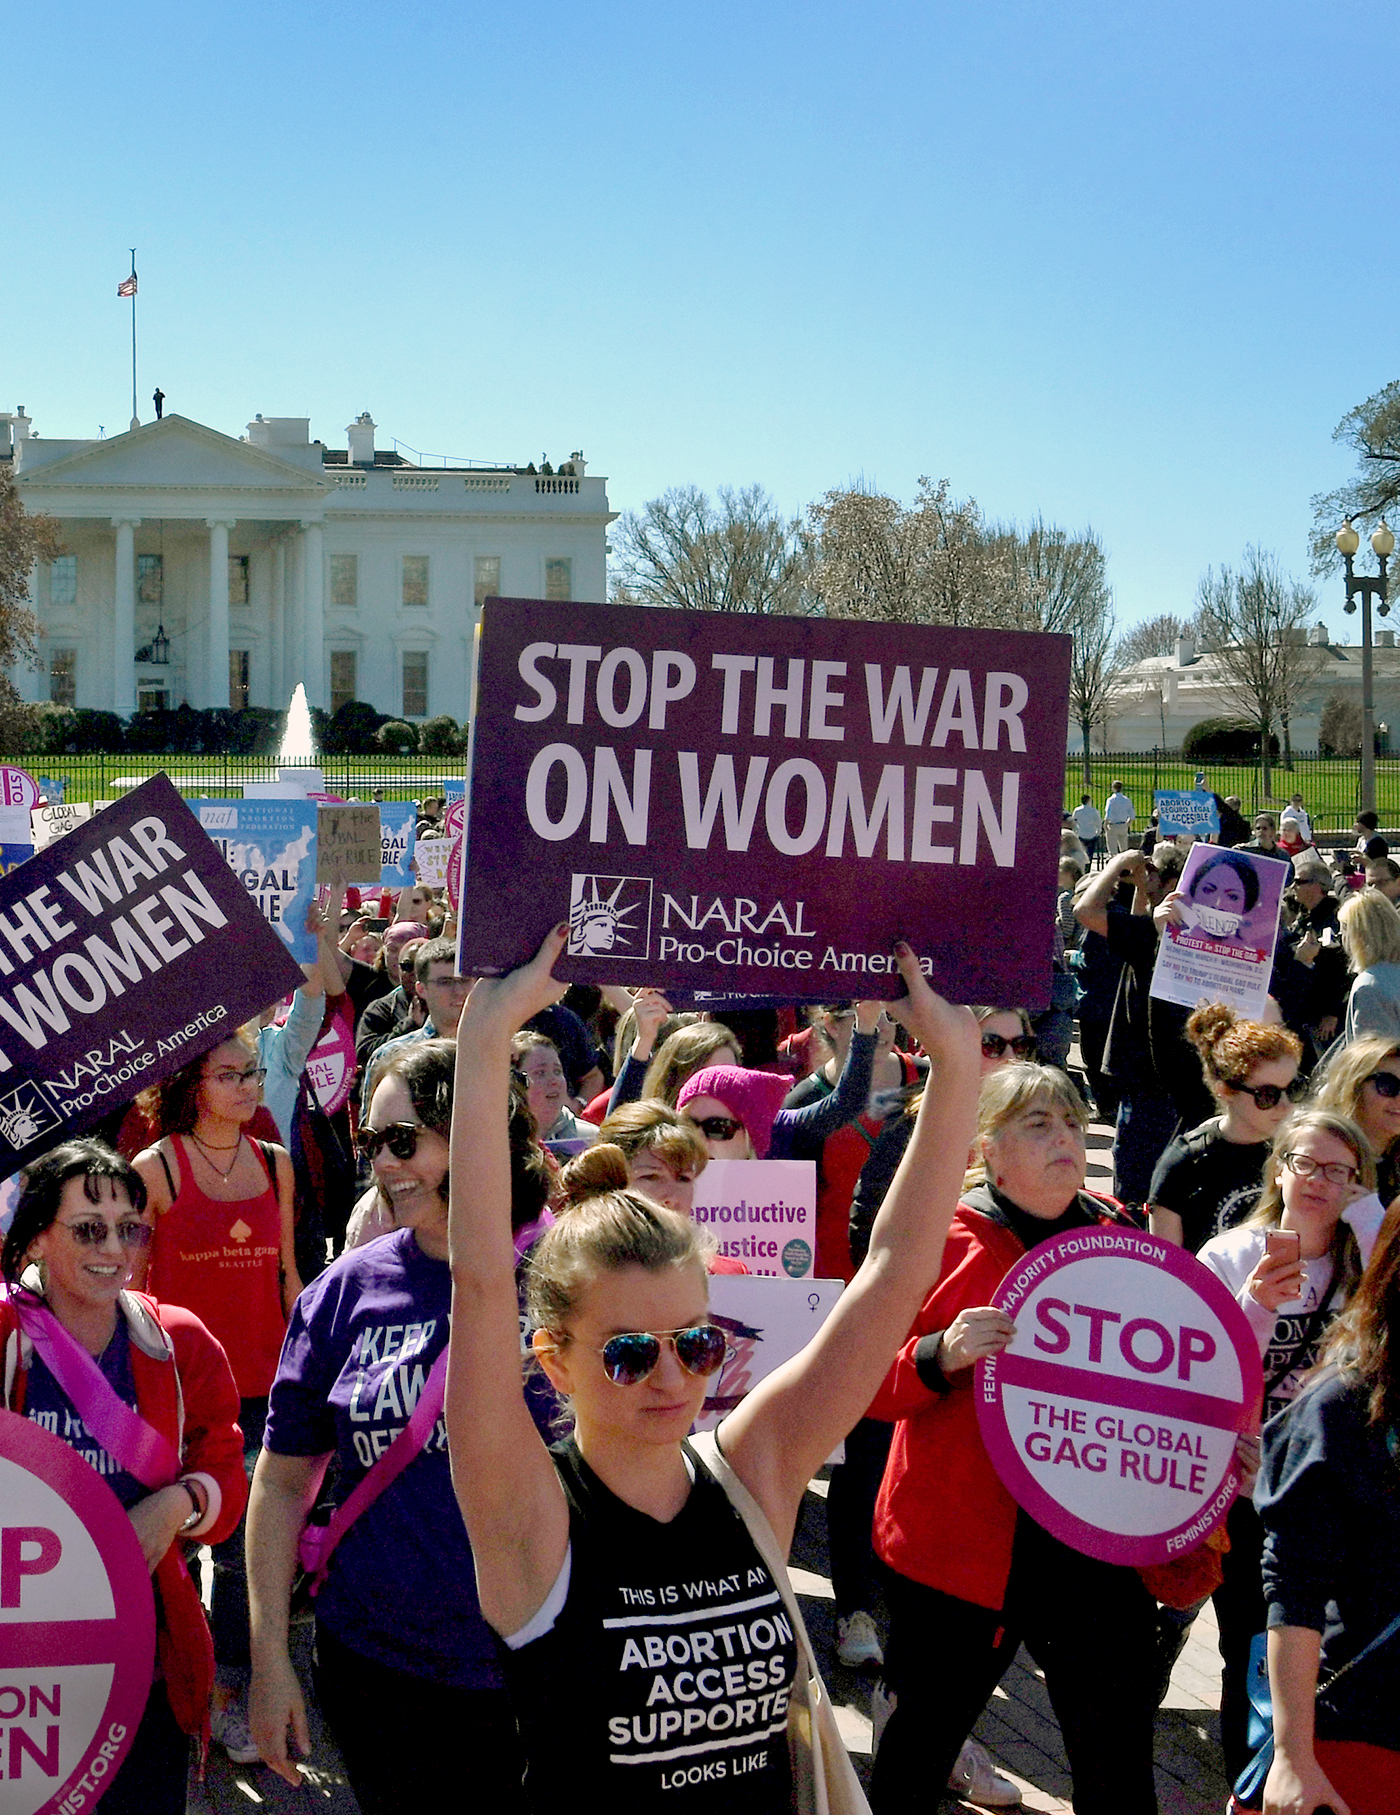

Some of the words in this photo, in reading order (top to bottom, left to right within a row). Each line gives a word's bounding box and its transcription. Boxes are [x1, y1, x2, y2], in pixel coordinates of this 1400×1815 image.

[513, 642, 697, 730] STOP
[712, 653, 848, 741] THE
[864, 662, 1029, 752] WAR
[11, 775, 23, 805] STO
[525, 742, 652, 846] ON
[678, 751, 1020, 868] WOMEN
[42, 806, 81, 822] GLOBAL
[49, 820, 73, 835] GAG
[204, 808, 234, 829] naf
[349, 810, 374, 824] the
[57, 816, 186, 918] WAR
[661, 893, 816, 937] NARAL
[659, 937, 813, 971] Pro-Choice
[819, 946, 933, 976] Amera
[1214, 944, 1230, 956] STOP
[1231, 948, 1244, 959] THE
[44, 1029, 144, 1100] NARAL
[60, 1052, 156, 1119] Pro-Choice
[157, 1003, 228, 1055] America
[180, 1250, 220, 1262] kappa
[223, 1246, 251, 1257] beta
[219, 1259, 263, 1269] SEATTLE
[1000, 1250, 1055, 1315] MAJORITY
[1058, 1235, 1167, 1262] FOUNDATION
[359, 1319, 437, 1365] KEEP
[1033, 1297, 1217, 1382] STOP
[1028, 1401, 1087, 1434] THE
[1095, 1416, 1209, 1460] GLOBAL
[1024, 1431, 1107, 1473] GAG
[1119, 1449, 1207, 1495] RULE
[1166, 1475, 1238, 1553] FEMINIST.ORG
[619, 1587, 656, 1605] THIS
[660, 1586, 679, 1604] IS
[682, 1575, 740, 1600] WHAT
[747, 1566, 768, 1586] AN
[619, 1612, 794, 1672] ABORTION
[646, 1655, 786, 1707] ACCESS
[661, 1760, 727, 1790] LOOKS
[733, 1751, 768, 1776] LIKE
